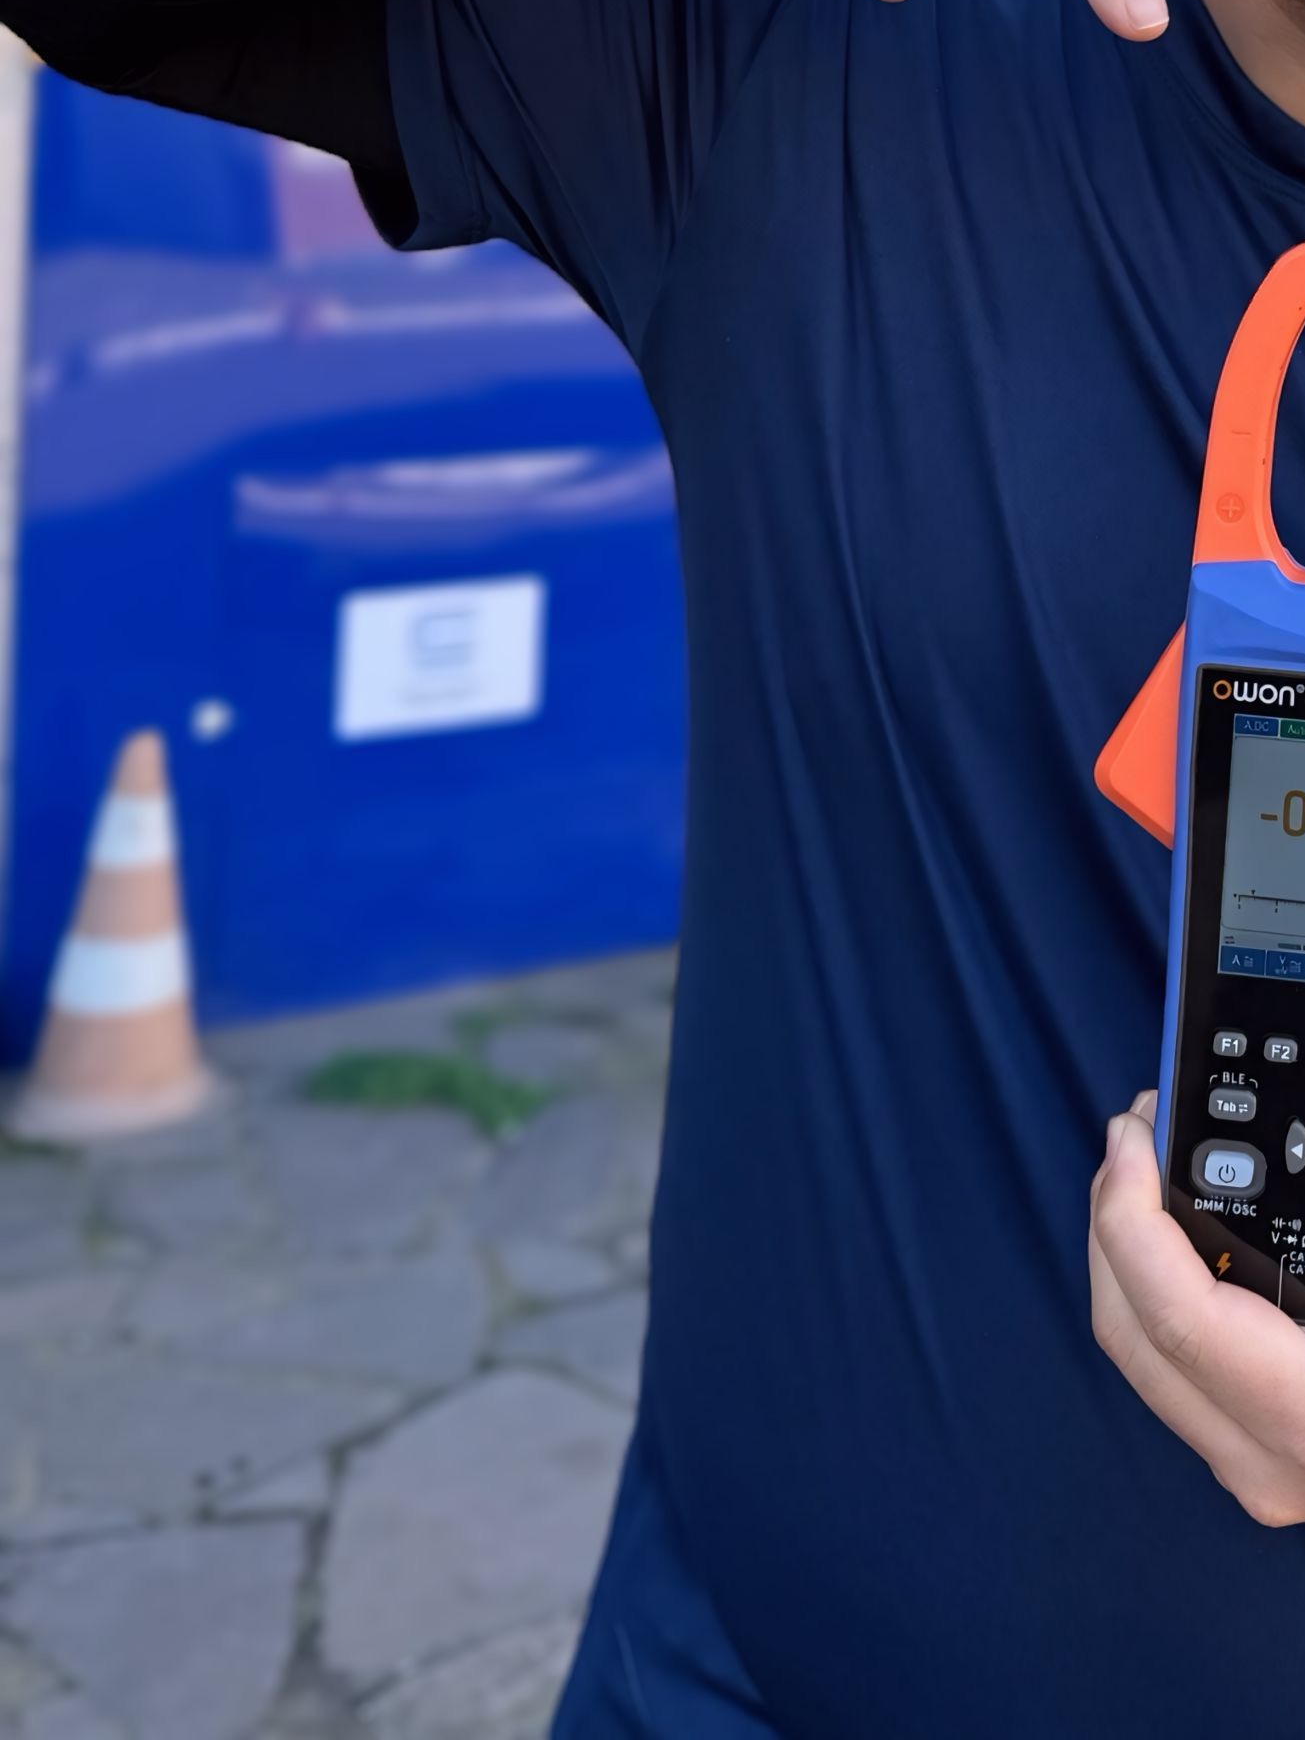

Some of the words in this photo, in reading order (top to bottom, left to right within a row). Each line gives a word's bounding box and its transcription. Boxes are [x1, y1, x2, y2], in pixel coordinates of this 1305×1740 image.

[1221, 1038, 1239, 1054] F1
[1271, 1044, 1290, 1060] F2
[1222, 1072, 1245, 1085] BLE
[1216, 1099, 1236, 1112] Tab
[1194, 1198, 1257, 1217] DMM/OSC
